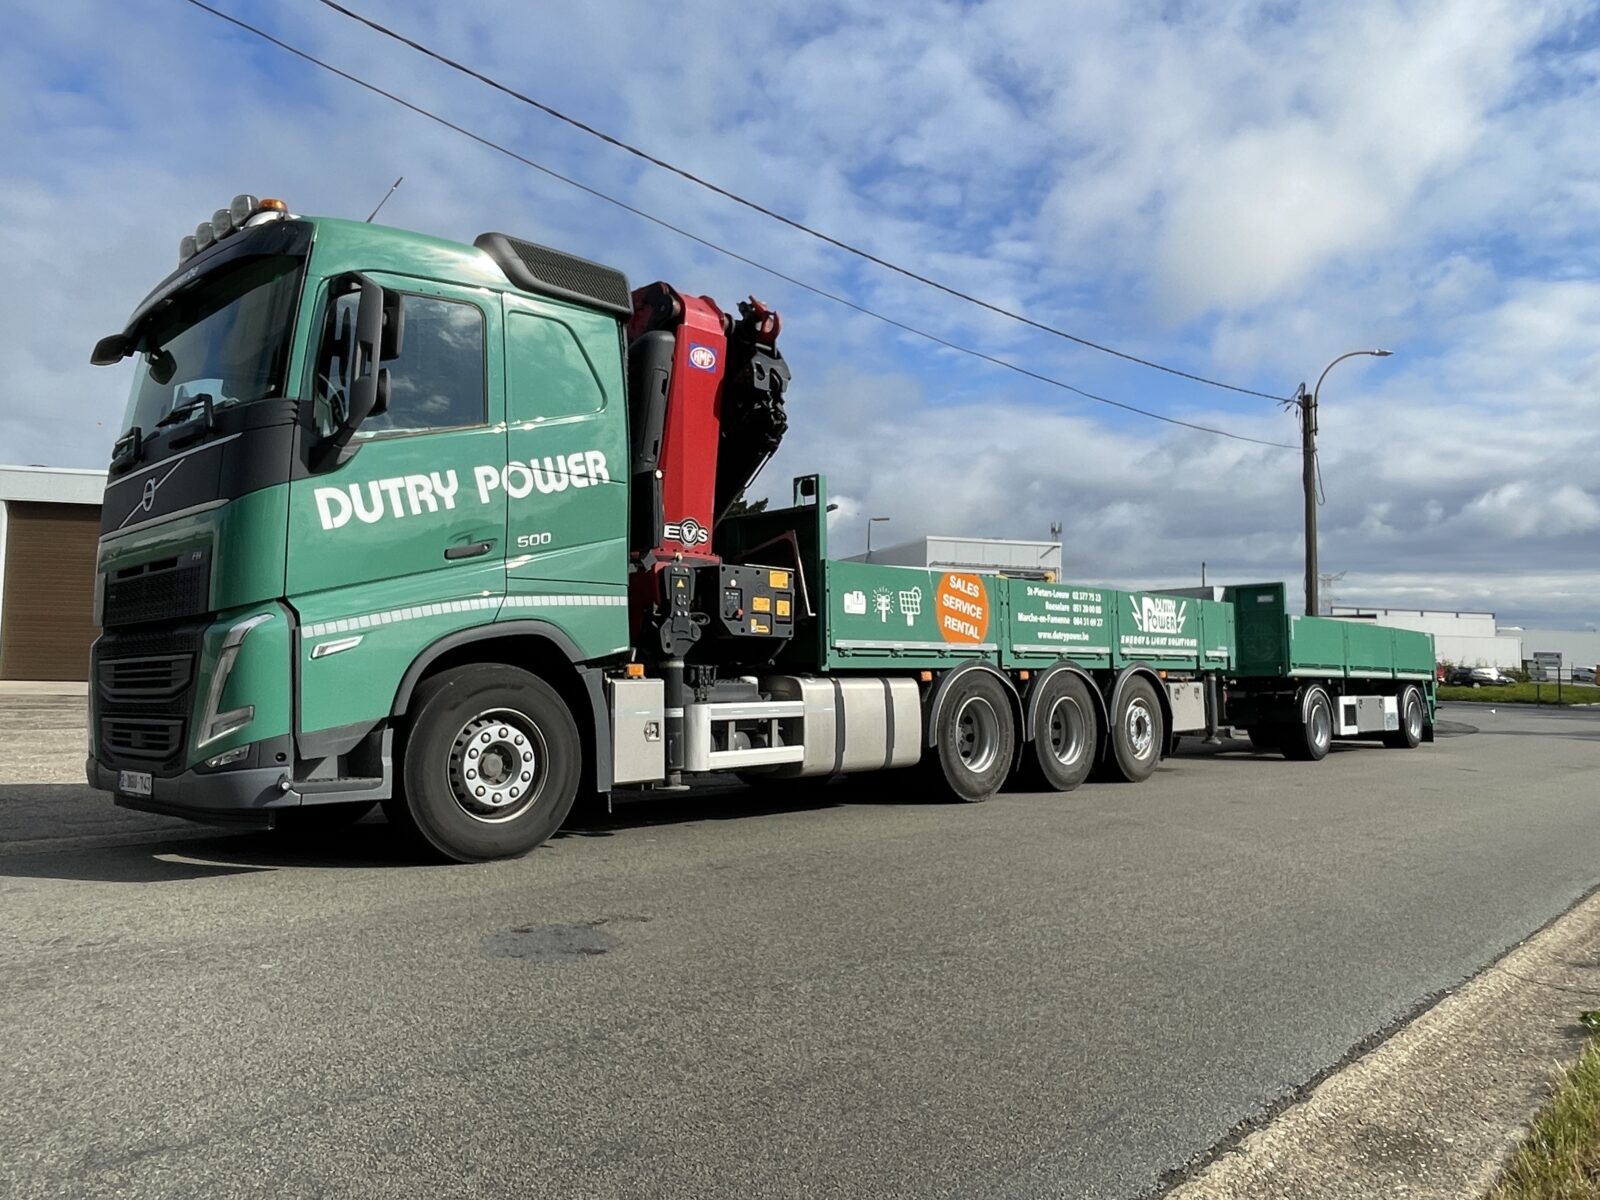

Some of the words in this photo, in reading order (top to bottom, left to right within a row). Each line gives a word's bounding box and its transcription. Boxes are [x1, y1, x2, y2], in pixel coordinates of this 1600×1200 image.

[693, 350, 713, 366] HMF
[313, 469, 460, 531] DUTRY
[474, 450, 610, 504] POWER
[517, 532, 552, 548] 500
[949, 575, 980, 598] SALES
[942, 593, 983, 620] SERVICE
[1154, 598, 1176, 613] DUTRY
[943, 615, 980, 640] RENTAL
[1147, 608, 1176, 631] POWER
[1037, 630, 1089, 642] www.dutrypower.be
[1120, 635, 1145, 644] ENERGY
[1150, 636, 1167, 646] LIGHT
[1167, 637, 1197, 647] SOLUTIONS
